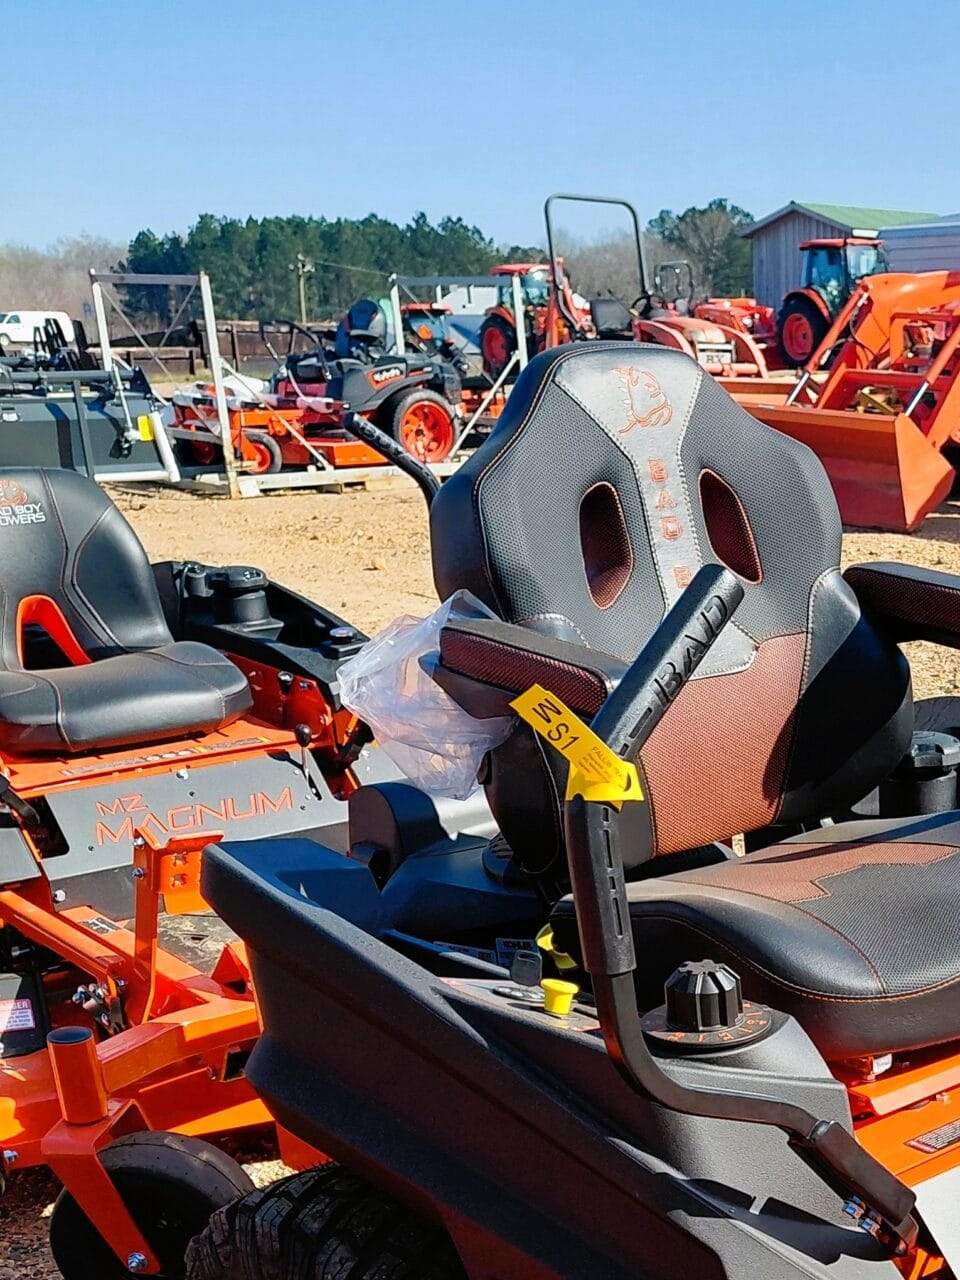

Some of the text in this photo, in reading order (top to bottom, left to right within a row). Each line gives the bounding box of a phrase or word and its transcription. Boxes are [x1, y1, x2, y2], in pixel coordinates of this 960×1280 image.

[16, 503, 41, 514] BOY
[95, 793, 149, 817] MZ
[95, 786, 294, 846] MAGNUM
